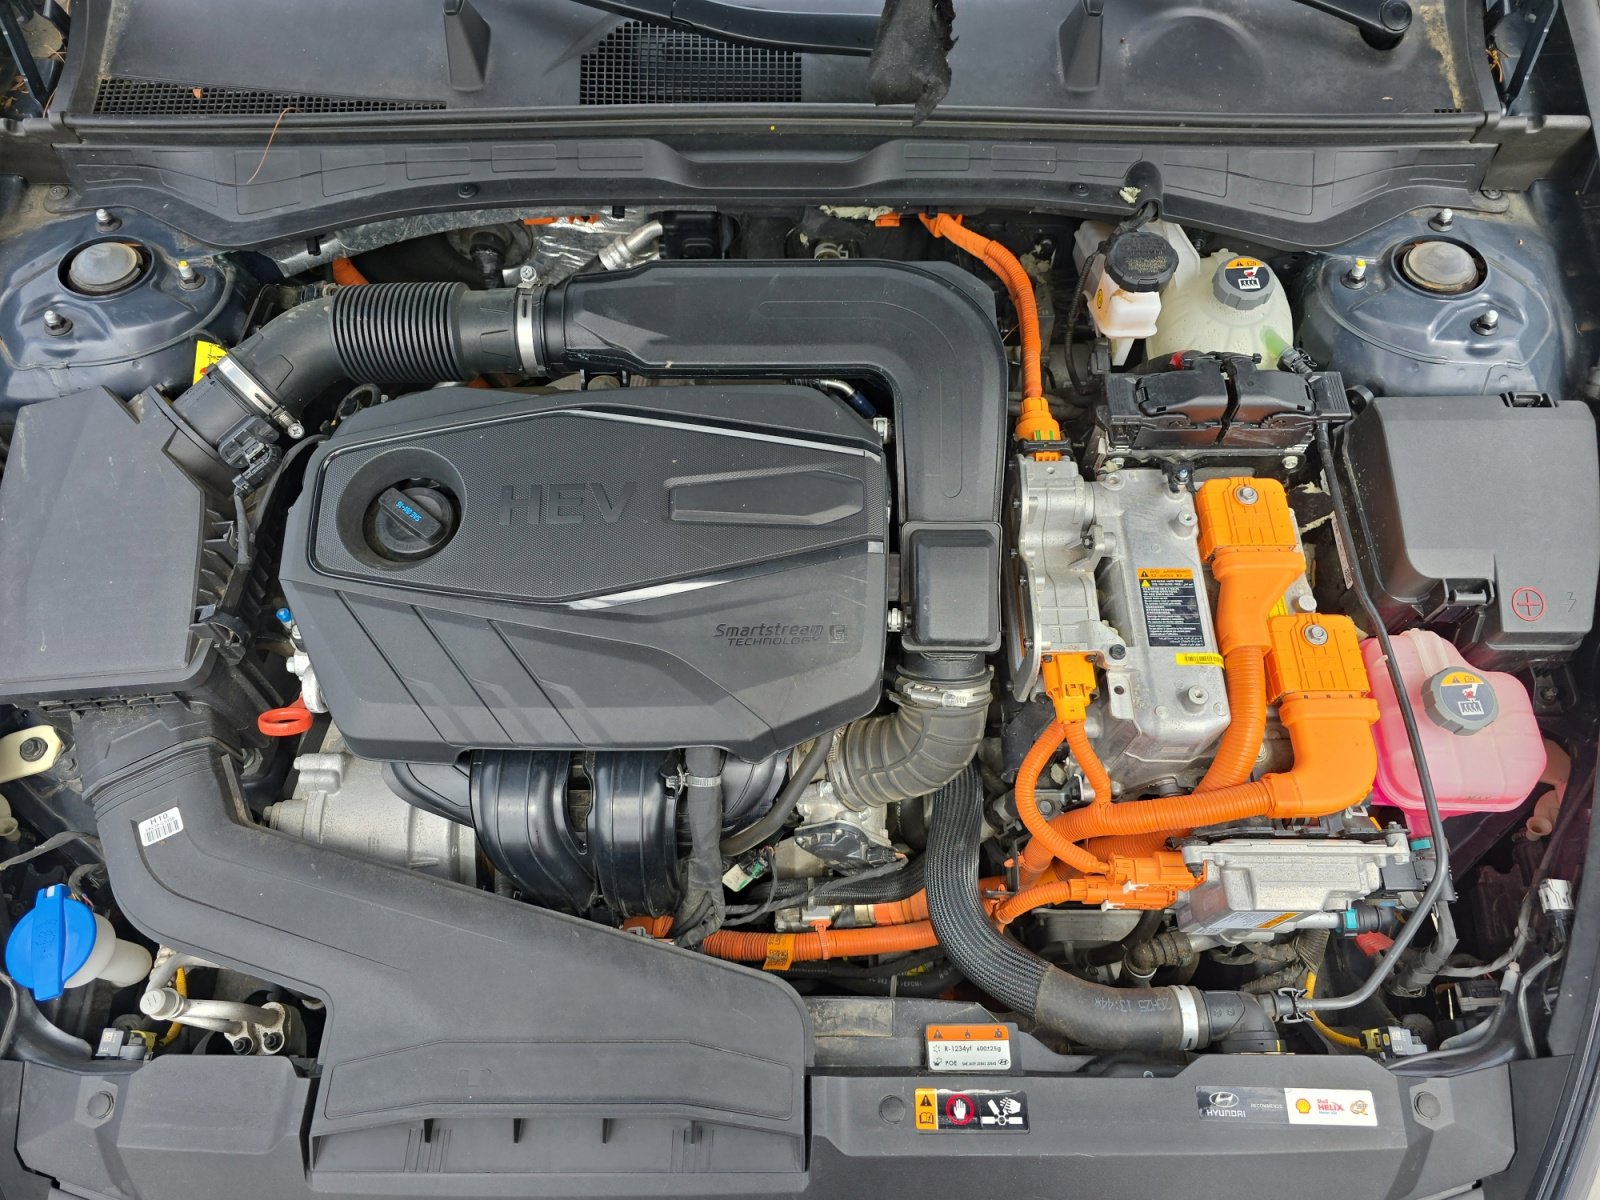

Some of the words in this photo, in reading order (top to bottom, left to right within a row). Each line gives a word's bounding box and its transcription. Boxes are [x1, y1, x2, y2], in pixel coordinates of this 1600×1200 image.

[500, 482, 636, 525] HEV
[410, 511, 422, 522] SAE
[713, 623, 824, 637] Smartstream
[728, 636, 820, 646] TECHNOLOGY
[944, 1045, 972, 1053] R-1234yf
[1206, 1109, 1246, 1118] HYUNDAI
